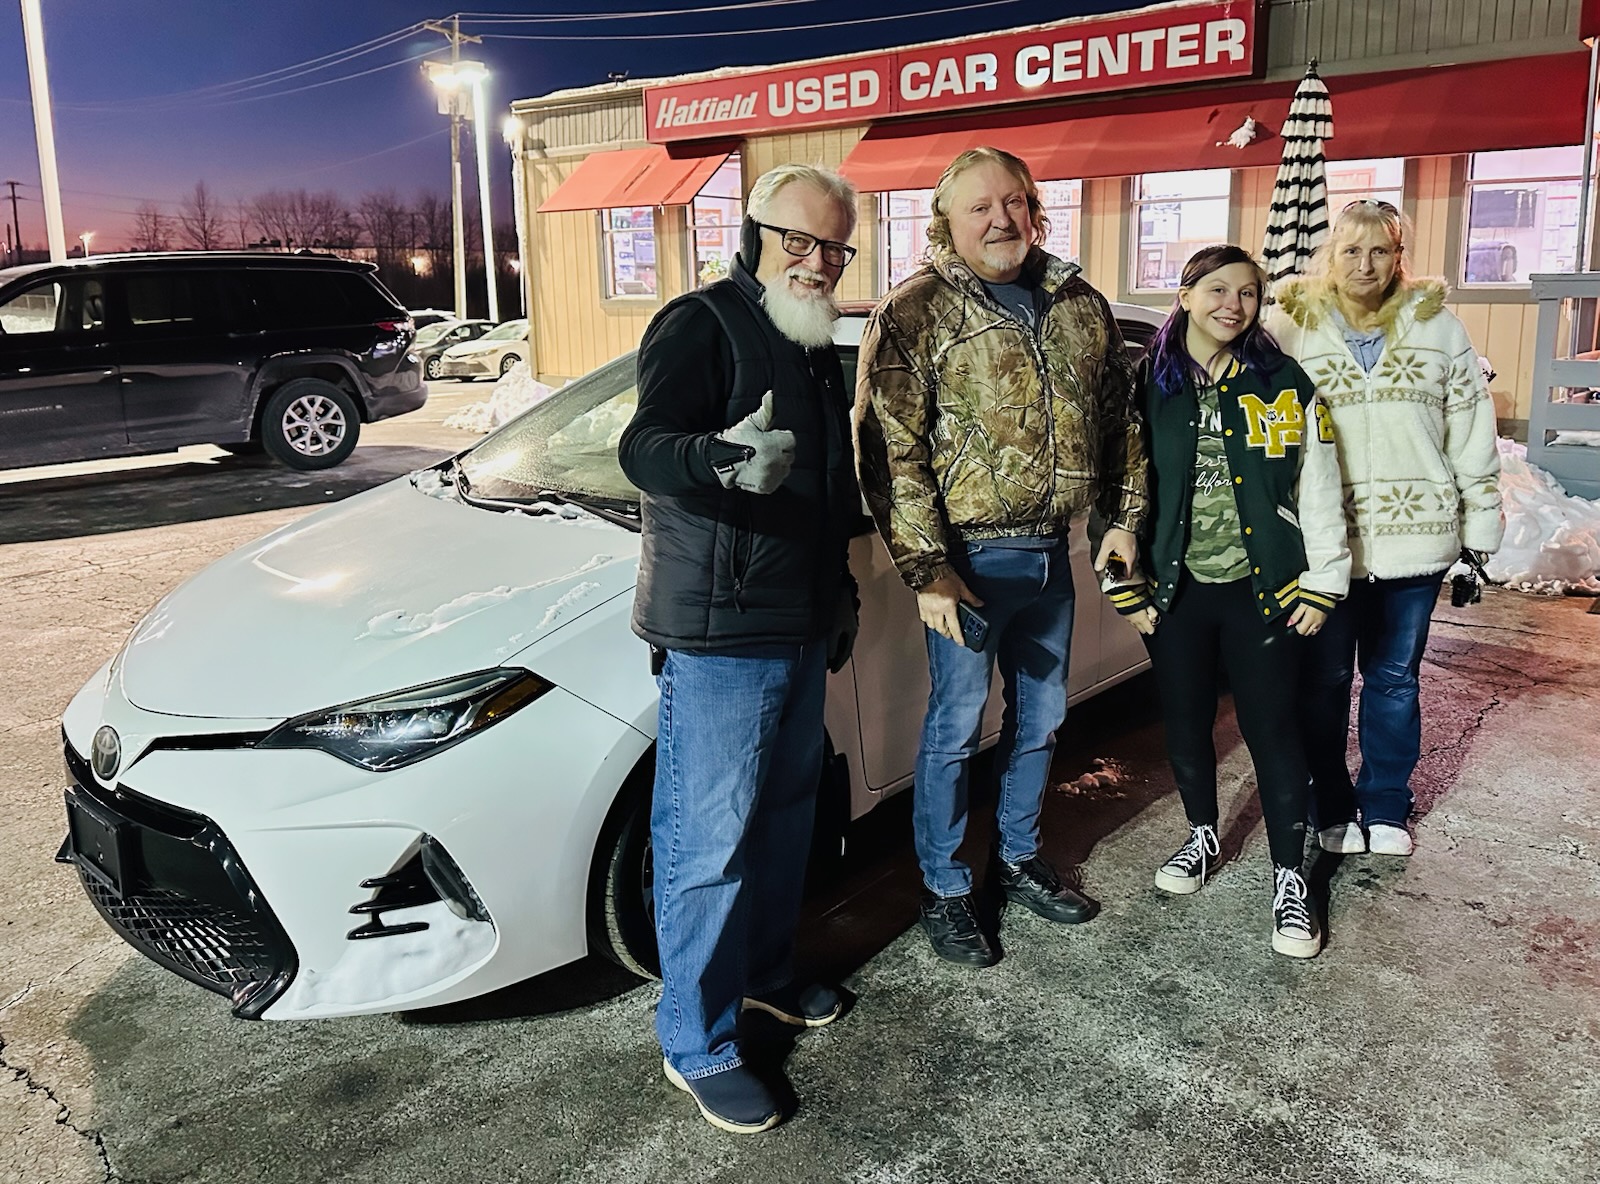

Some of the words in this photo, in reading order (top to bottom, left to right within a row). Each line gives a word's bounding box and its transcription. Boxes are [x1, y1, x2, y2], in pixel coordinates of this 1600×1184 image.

[656, 91, 758, 129] Hatfield
[768, 69, 880, 117] USED
[900, 52, 998, 101] CAR
[1015, 18, 1246, 89] CENTER
